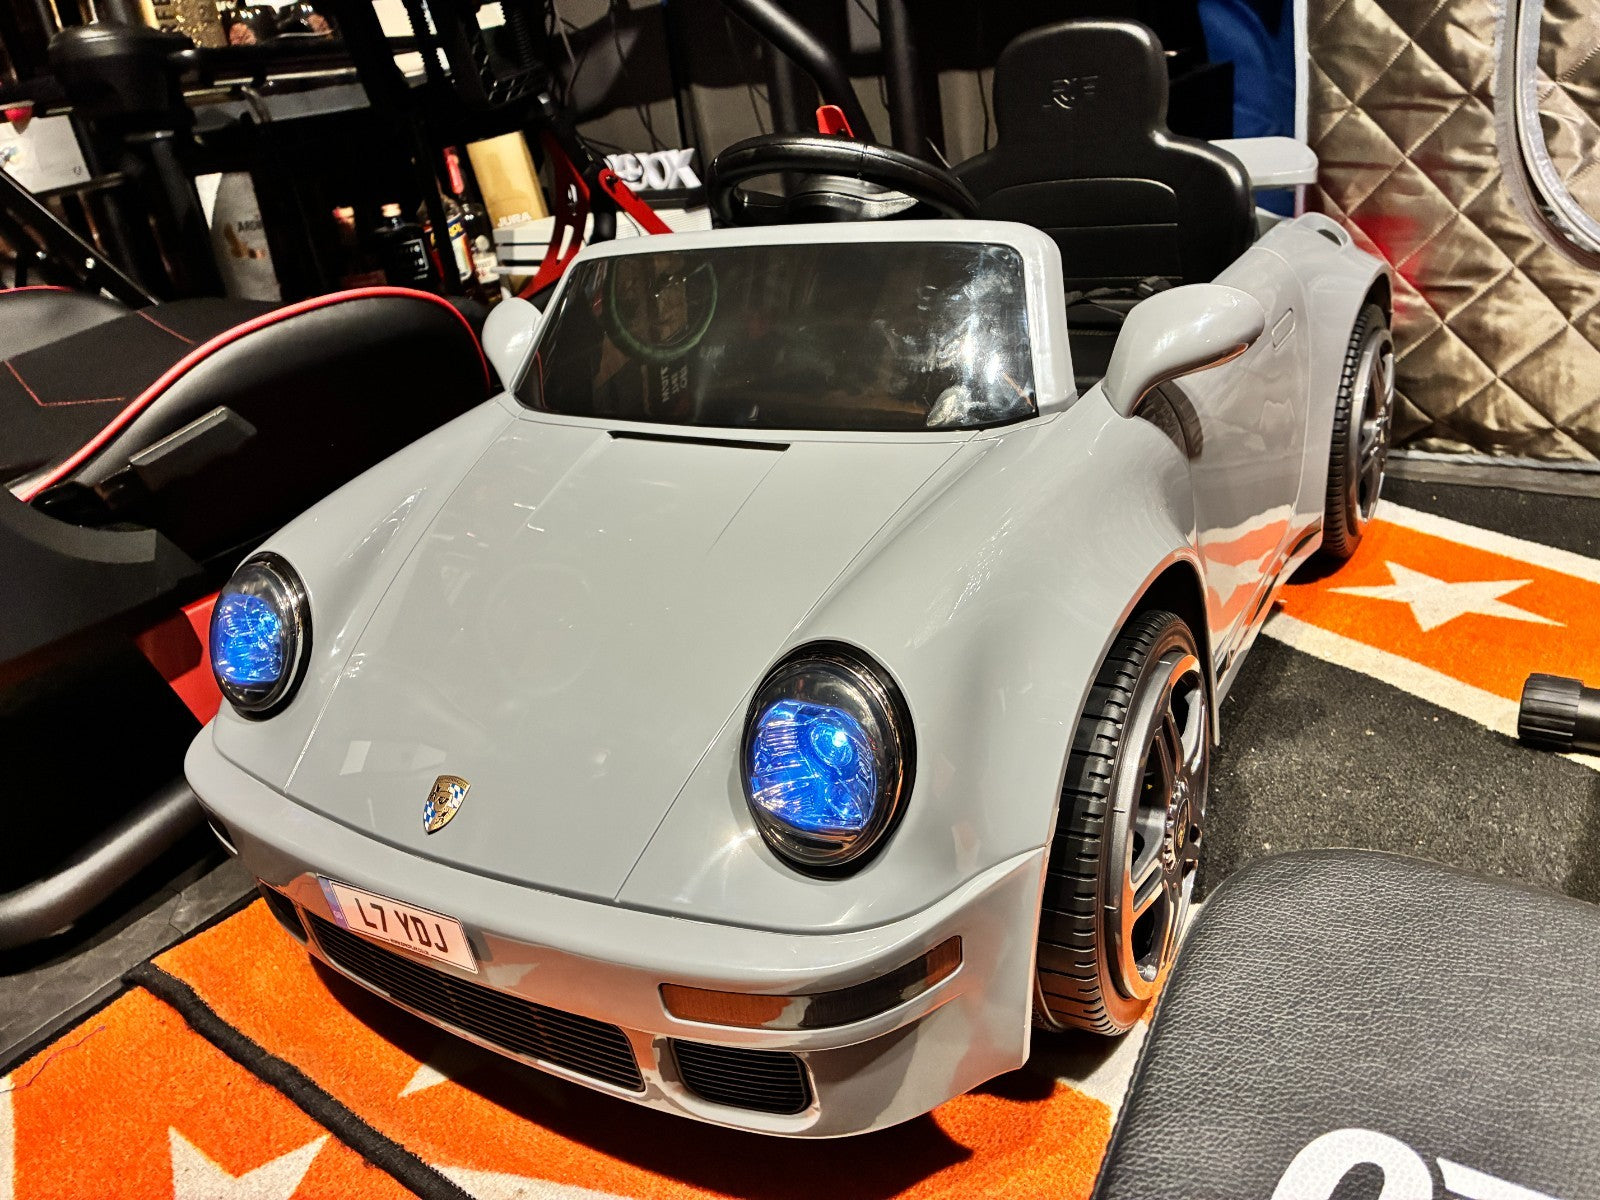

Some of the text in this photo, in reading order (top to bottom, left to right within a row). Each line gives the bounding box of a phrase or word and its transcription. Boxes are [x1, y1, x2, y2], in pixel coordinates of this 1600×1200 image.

[497, 211, 533, 227] JURA
[354, 897, 388, 933] L7
[393, 909, 449, 953] YDJ
